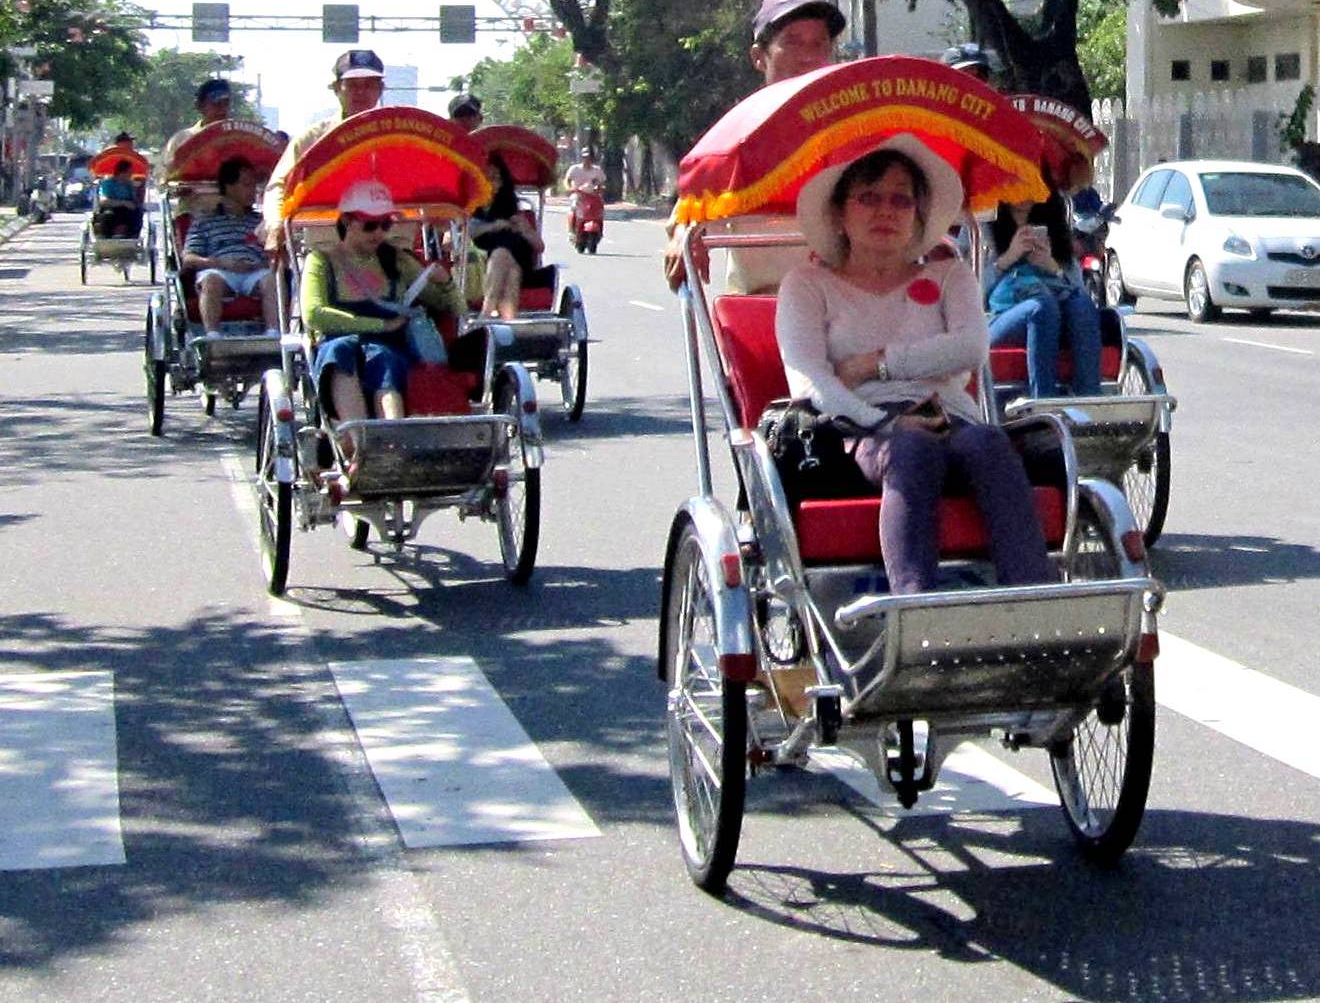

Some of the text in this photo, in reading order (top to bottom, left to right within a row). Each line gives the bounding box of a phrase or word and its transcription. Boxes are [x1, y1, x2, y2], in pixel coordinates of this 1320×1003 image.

[798, 78, 997, 124] WELCOME TO DANANG CITY
[1033, 99, 1076, 123] DANANG
[1073, 116, 1097, 139] CITY
